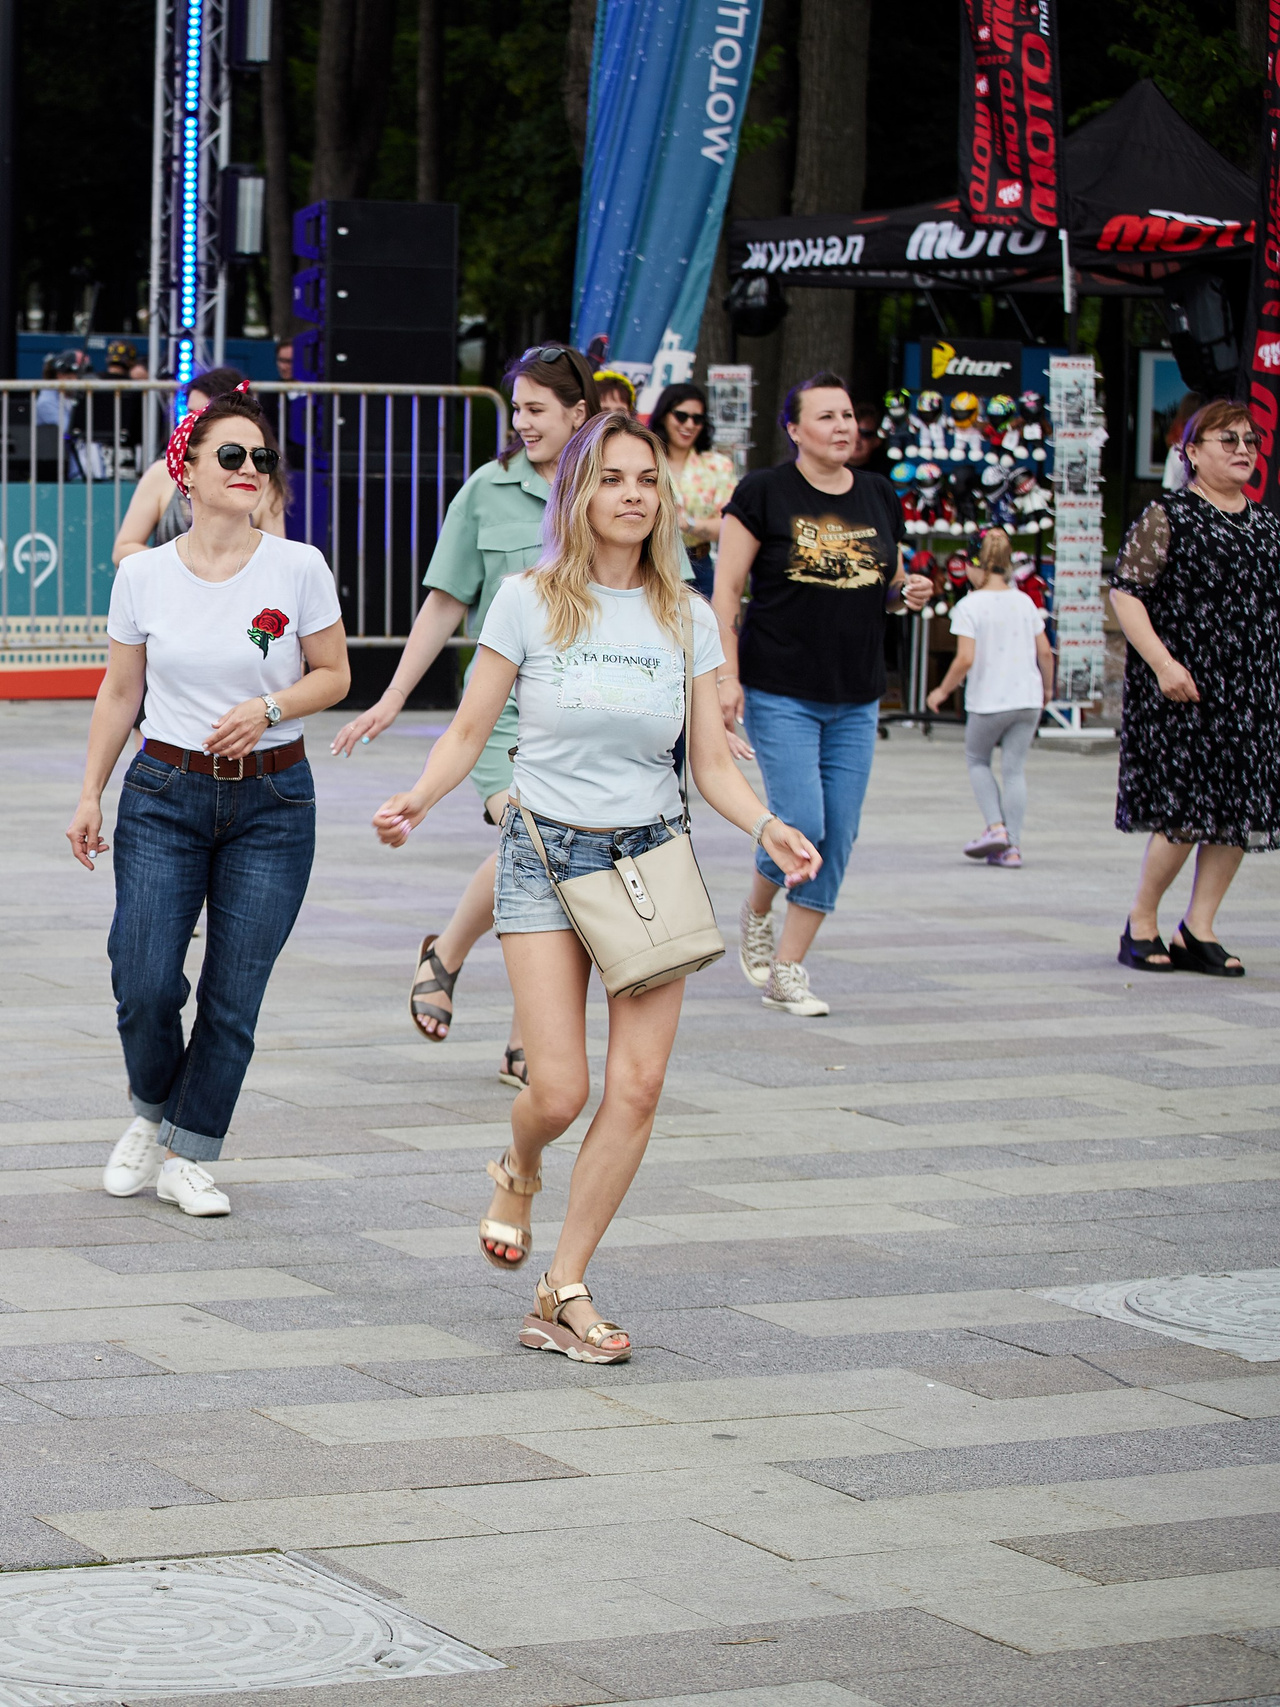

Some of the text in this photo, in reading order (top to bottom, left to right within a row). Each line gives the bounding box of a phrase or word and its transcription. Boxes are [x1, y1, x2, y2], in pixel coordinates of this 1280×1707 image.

[700, 0, 751, 165] МОТОЦ
[742, 234, 865, 273] журнал
[945, 356, 1012, 377] thor
[583, 653, 661, 668] LA BOTANIQUE
